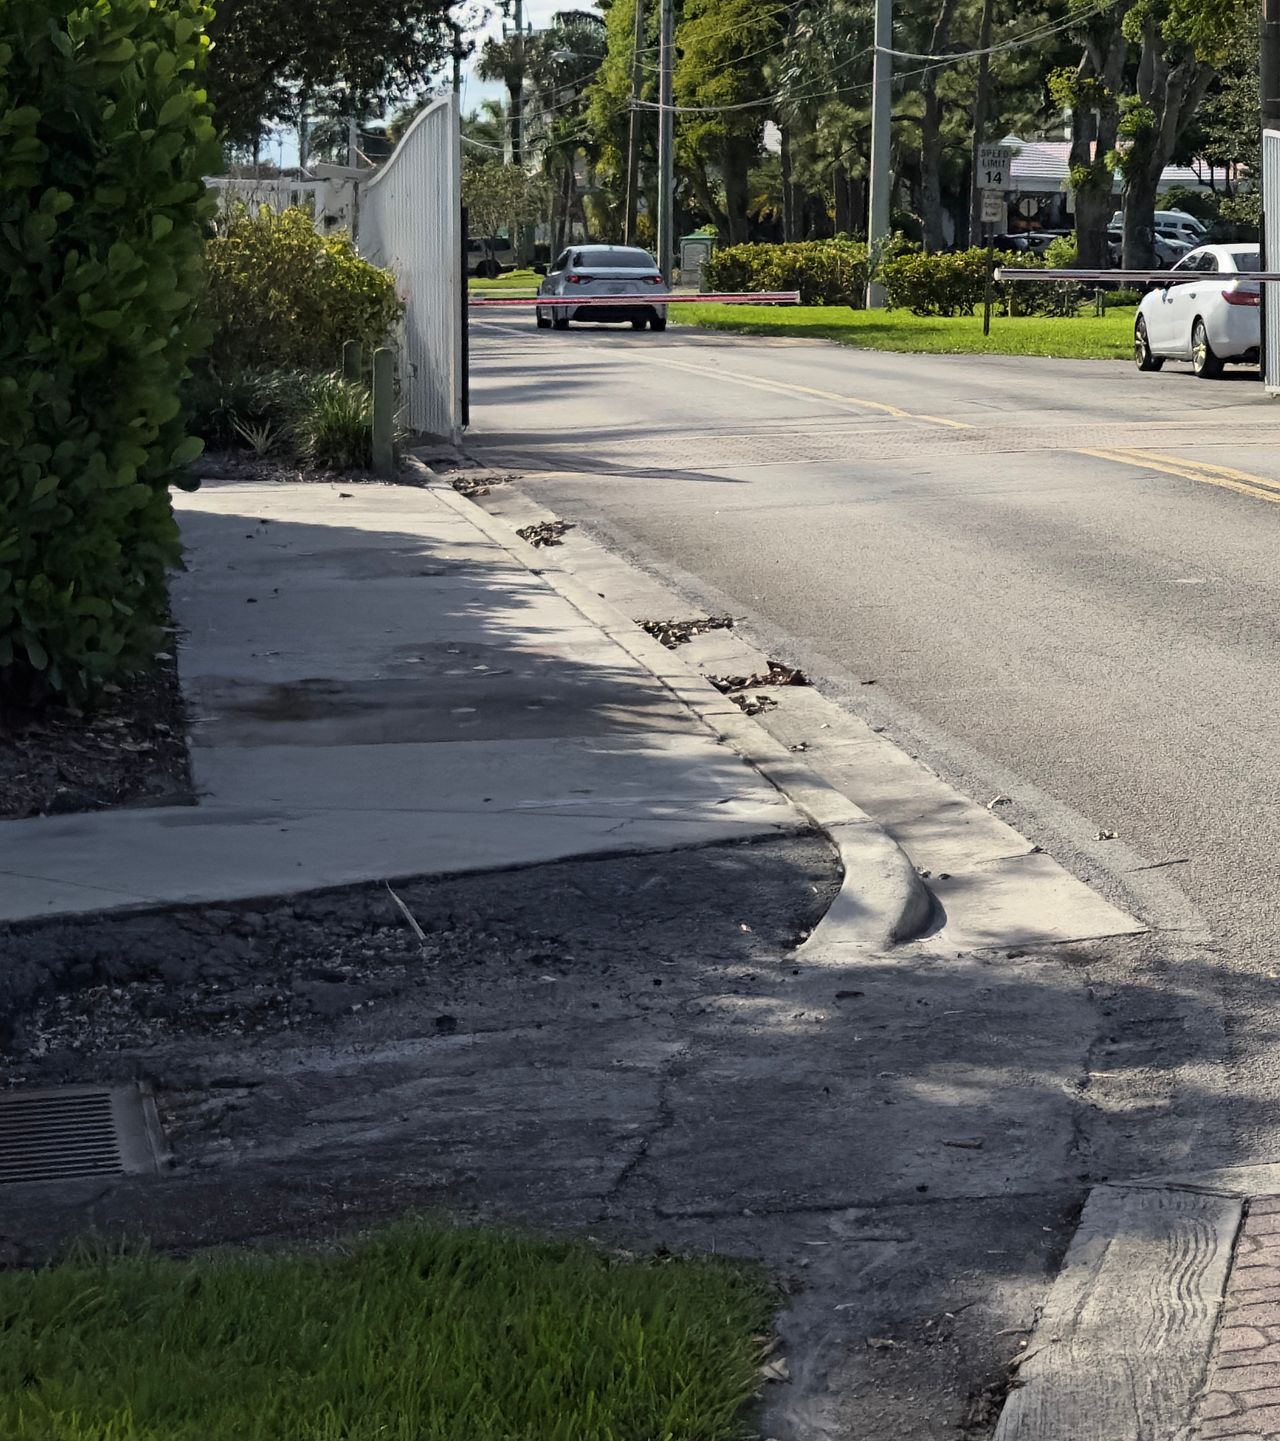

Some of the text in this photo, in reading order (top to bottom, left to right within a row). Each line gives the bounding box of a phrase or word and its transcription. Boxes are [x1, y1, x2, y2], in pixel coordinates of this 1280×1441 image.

[980, 149, 1009, 158] SPEED
[982, 159, 1006, 168] LIMIT
[985, 171, 1002, 185] 14
